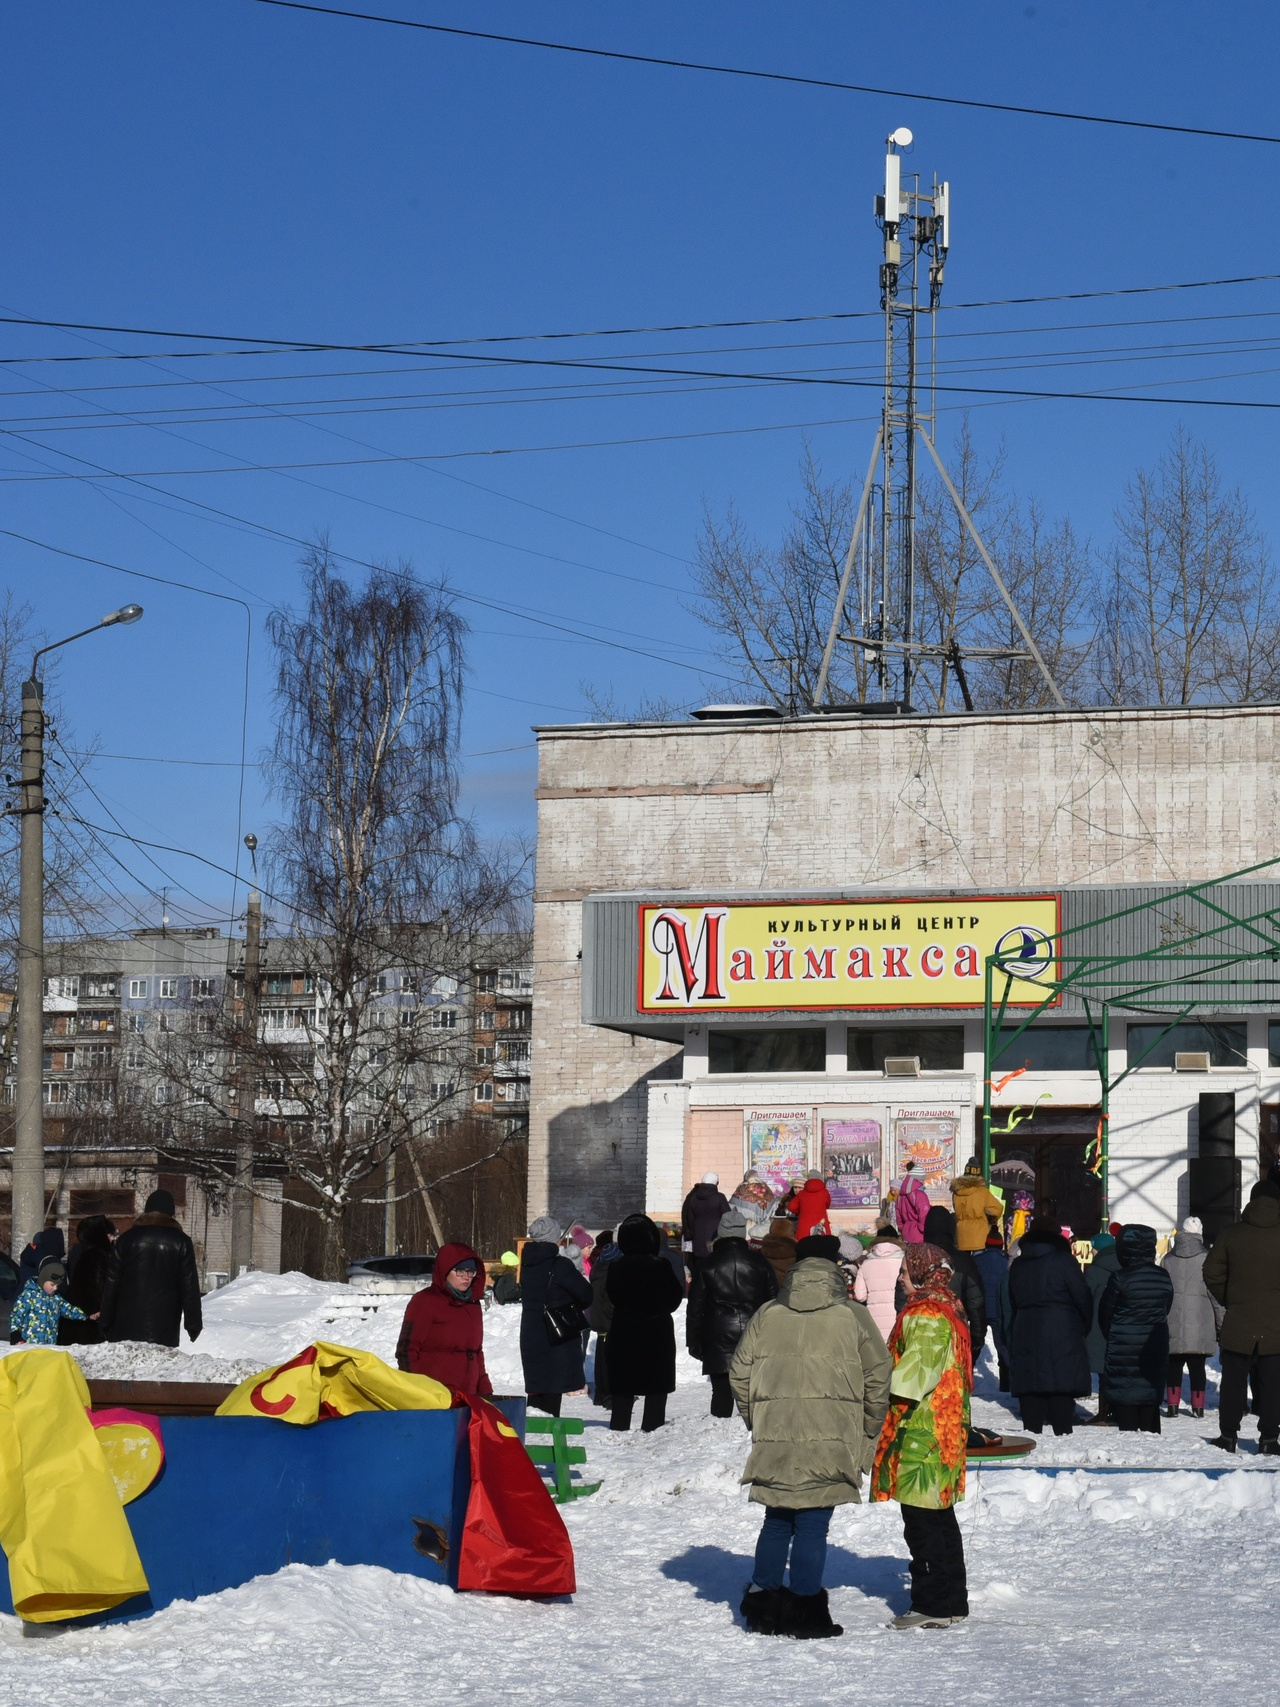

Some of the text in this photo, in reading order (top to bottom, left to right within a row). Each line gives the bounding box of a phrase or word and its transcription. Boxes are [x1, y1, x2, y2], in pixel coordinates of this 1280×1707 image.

[768, 914, 980, 933] КУЛЬТУРНЫЙ ЦЕНТР
[652, 910, 981, 1002] Маймакса
[751, 1111, 806, 1120] Приглашаем
[898, 1109, 954, 1118] Приглашаем
[827, 1128, 835, 1142] 5
[902, 1125, 907, 1135] 1
